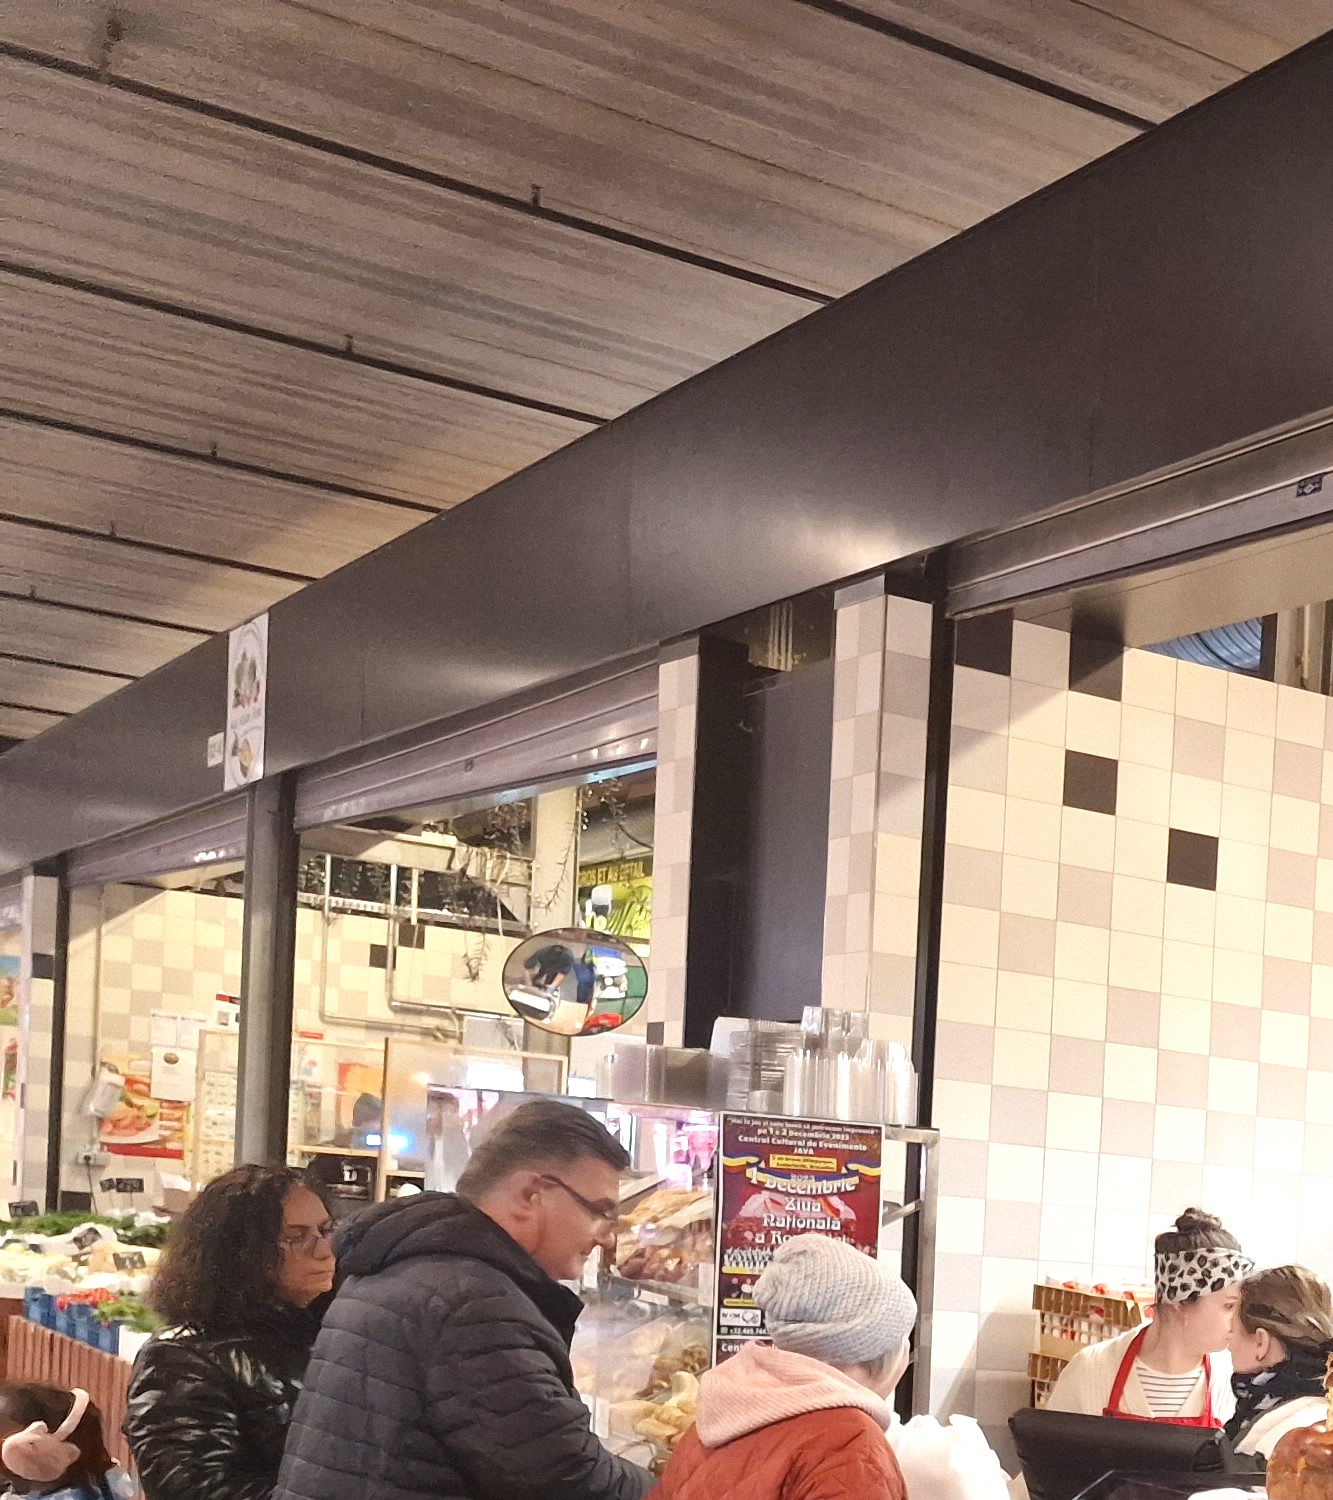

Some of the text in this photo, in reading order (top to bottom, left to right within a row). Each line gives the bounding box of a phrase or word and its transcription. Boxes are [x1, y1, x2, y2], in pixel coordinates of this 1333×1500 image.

[738, 1134, 868, 1152] Centrul Cultural de Evenimente
[793, 1147, 815, 1155] JAVA
[764, 1178, 857, 1195] Decembrie
[784, 1196, 822, 1212] Ziua
[755, 1233, 765, 1244] a
